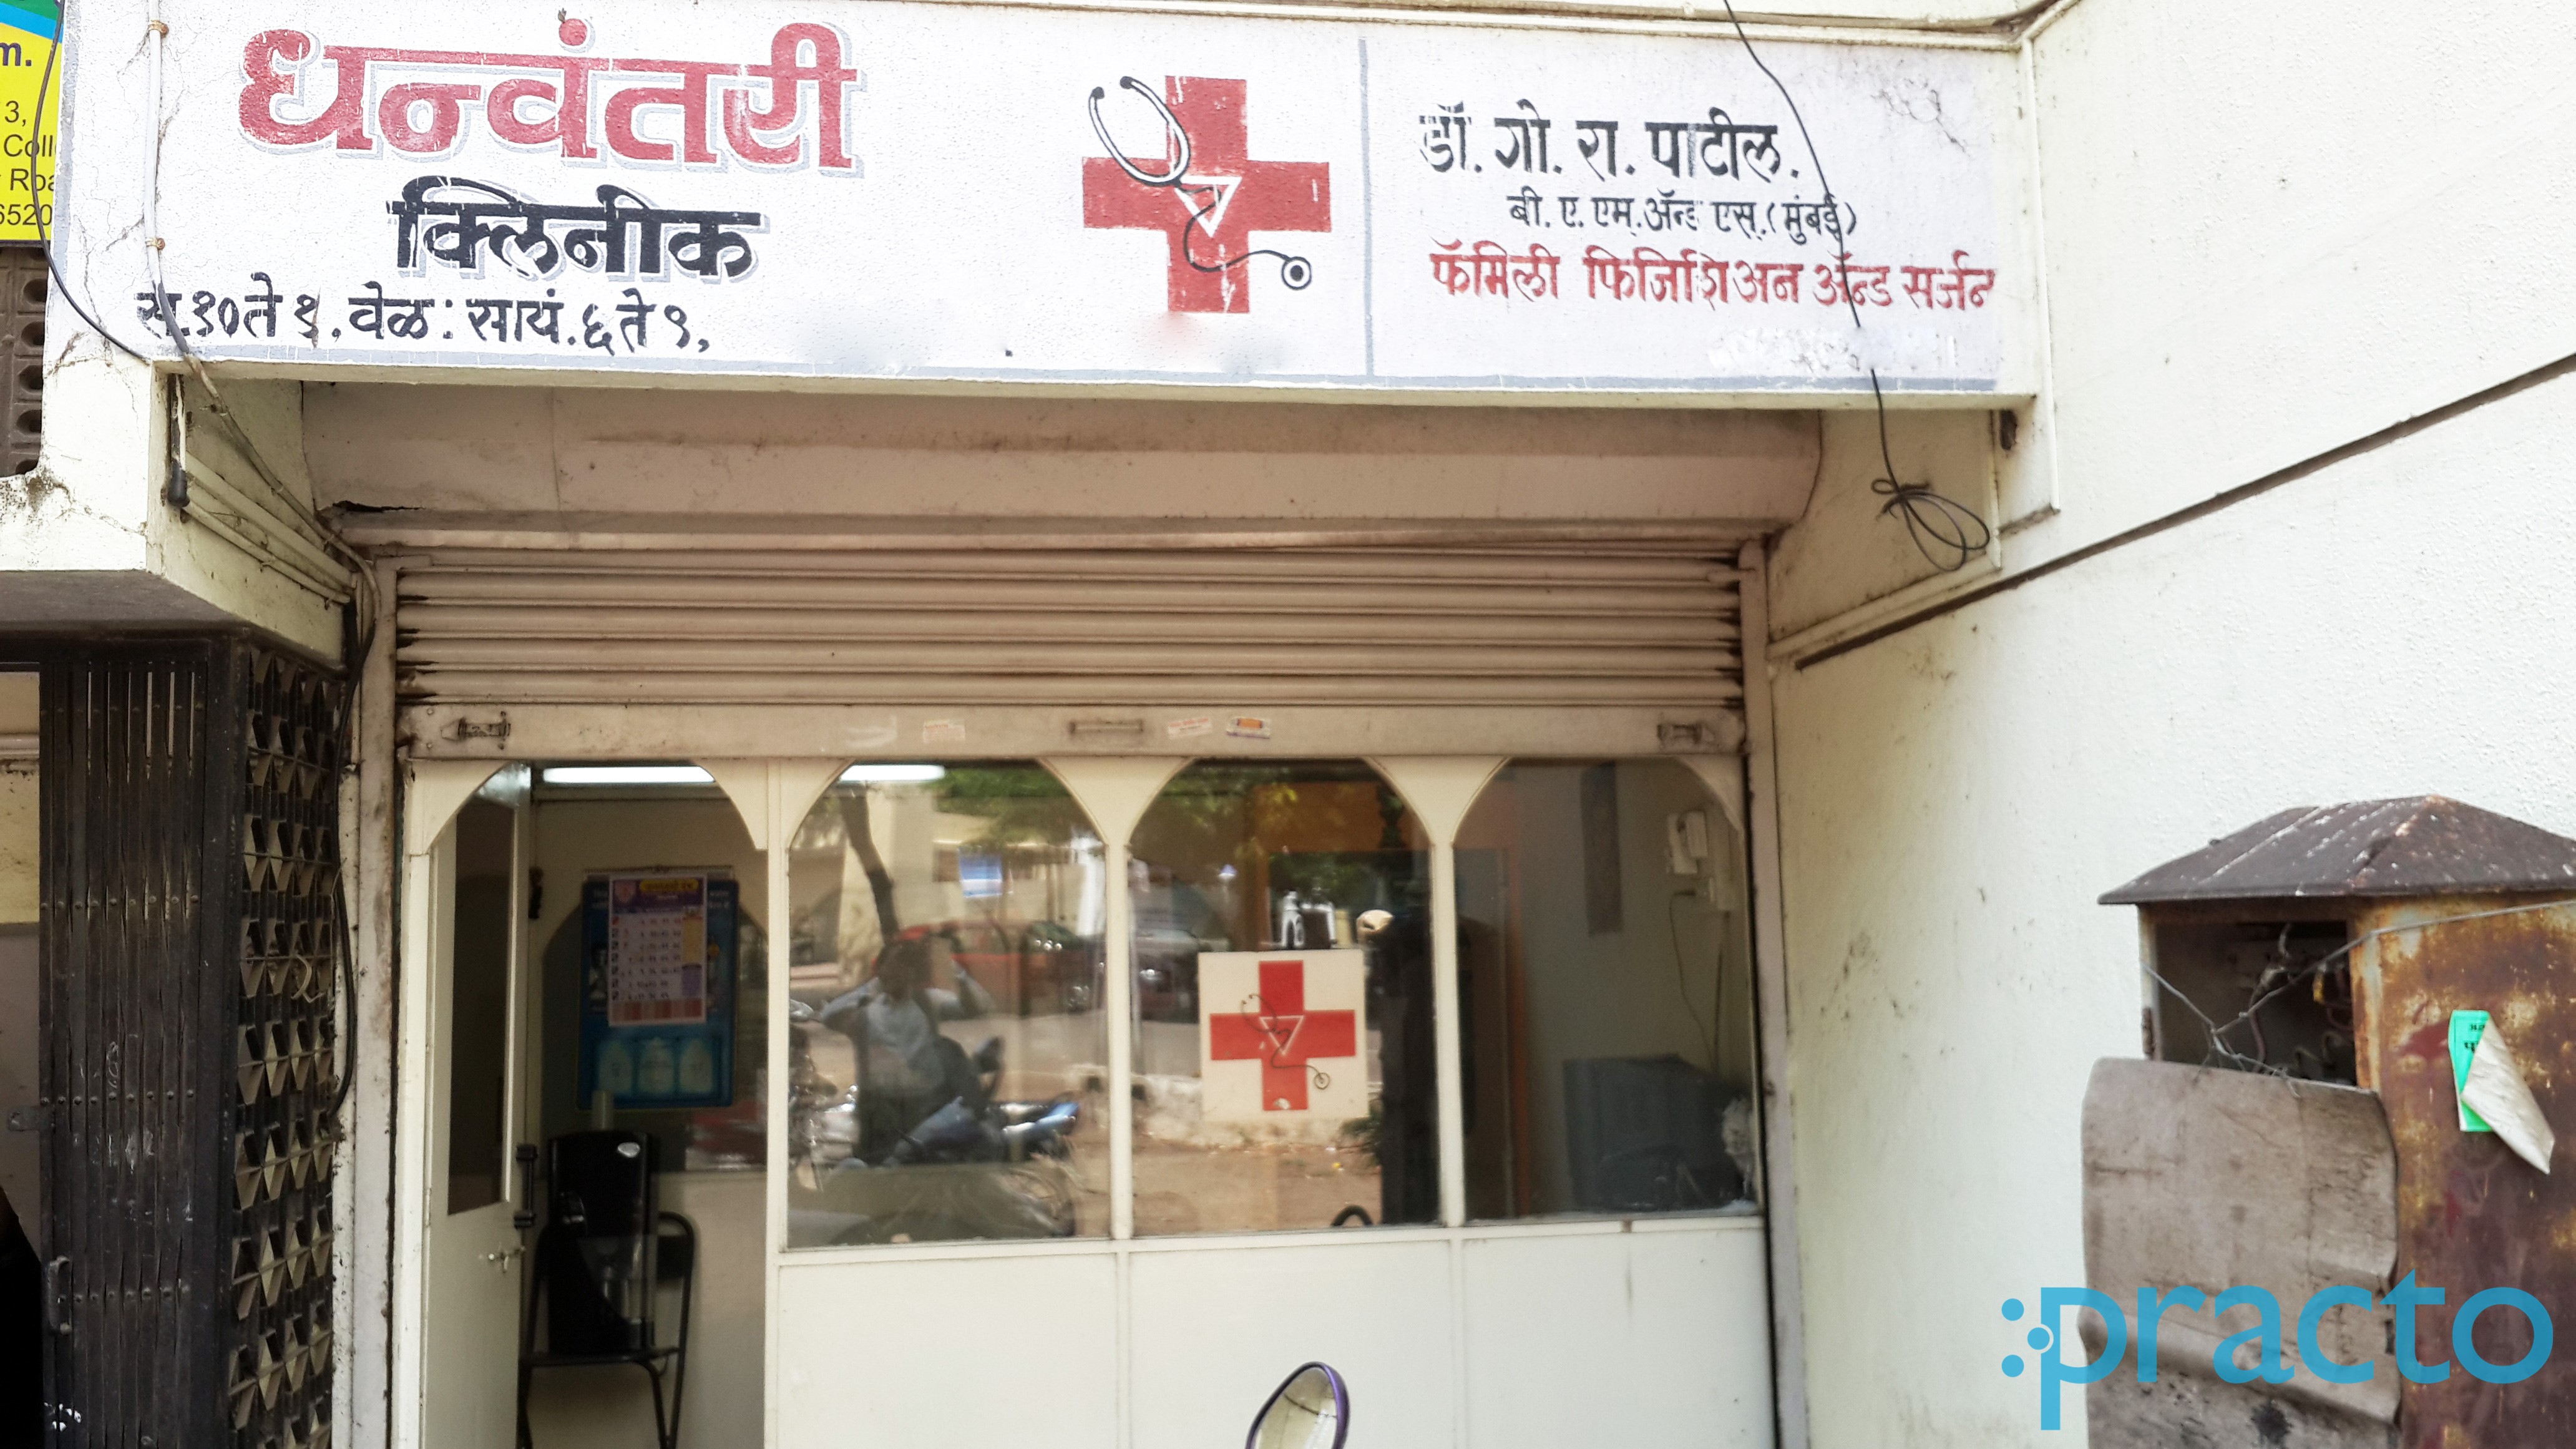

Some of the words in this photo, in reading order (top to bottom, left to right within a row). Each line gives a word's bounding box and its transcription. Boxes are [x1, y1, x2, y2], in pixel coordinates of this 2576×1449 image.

[4, 100, 26, 127] 3,
[4, 134, 57, 157] Coll
[1495, 99, 1563, 174] गो.
[1576, 120, 1636, 182] रा.
[1901, 250, 1996, 311] सर्जन
